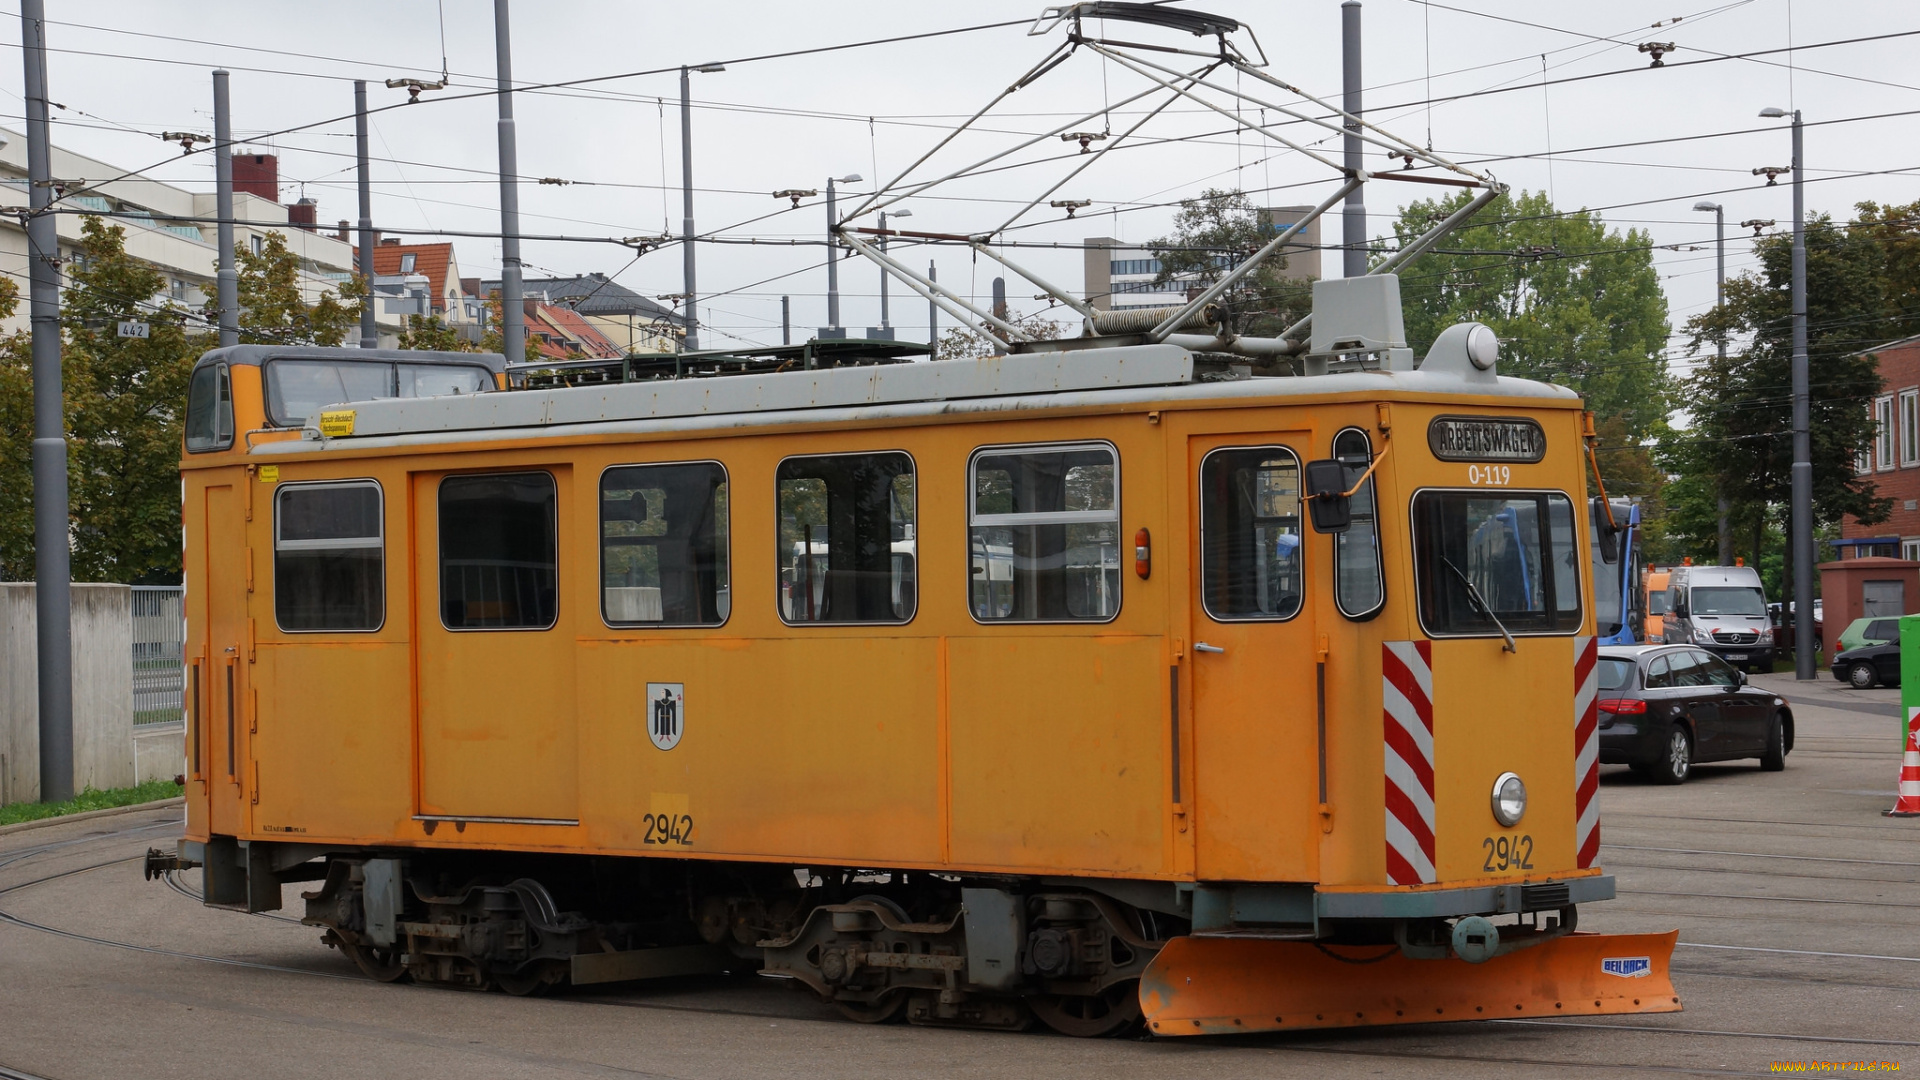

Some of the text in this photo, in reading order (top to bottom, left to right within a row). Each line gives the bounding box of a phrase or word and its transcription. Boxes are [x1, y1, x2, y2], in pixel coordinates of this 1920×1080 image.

[123, 325, 143, 337] 442
[1440, 427, 1535, 453] ARBEITSWAGEN
[643, 813, 693, 845] 2942
[1483, 835, 1533, 872] 2942
[1604, 959, 1648, 975] BEILHACK
